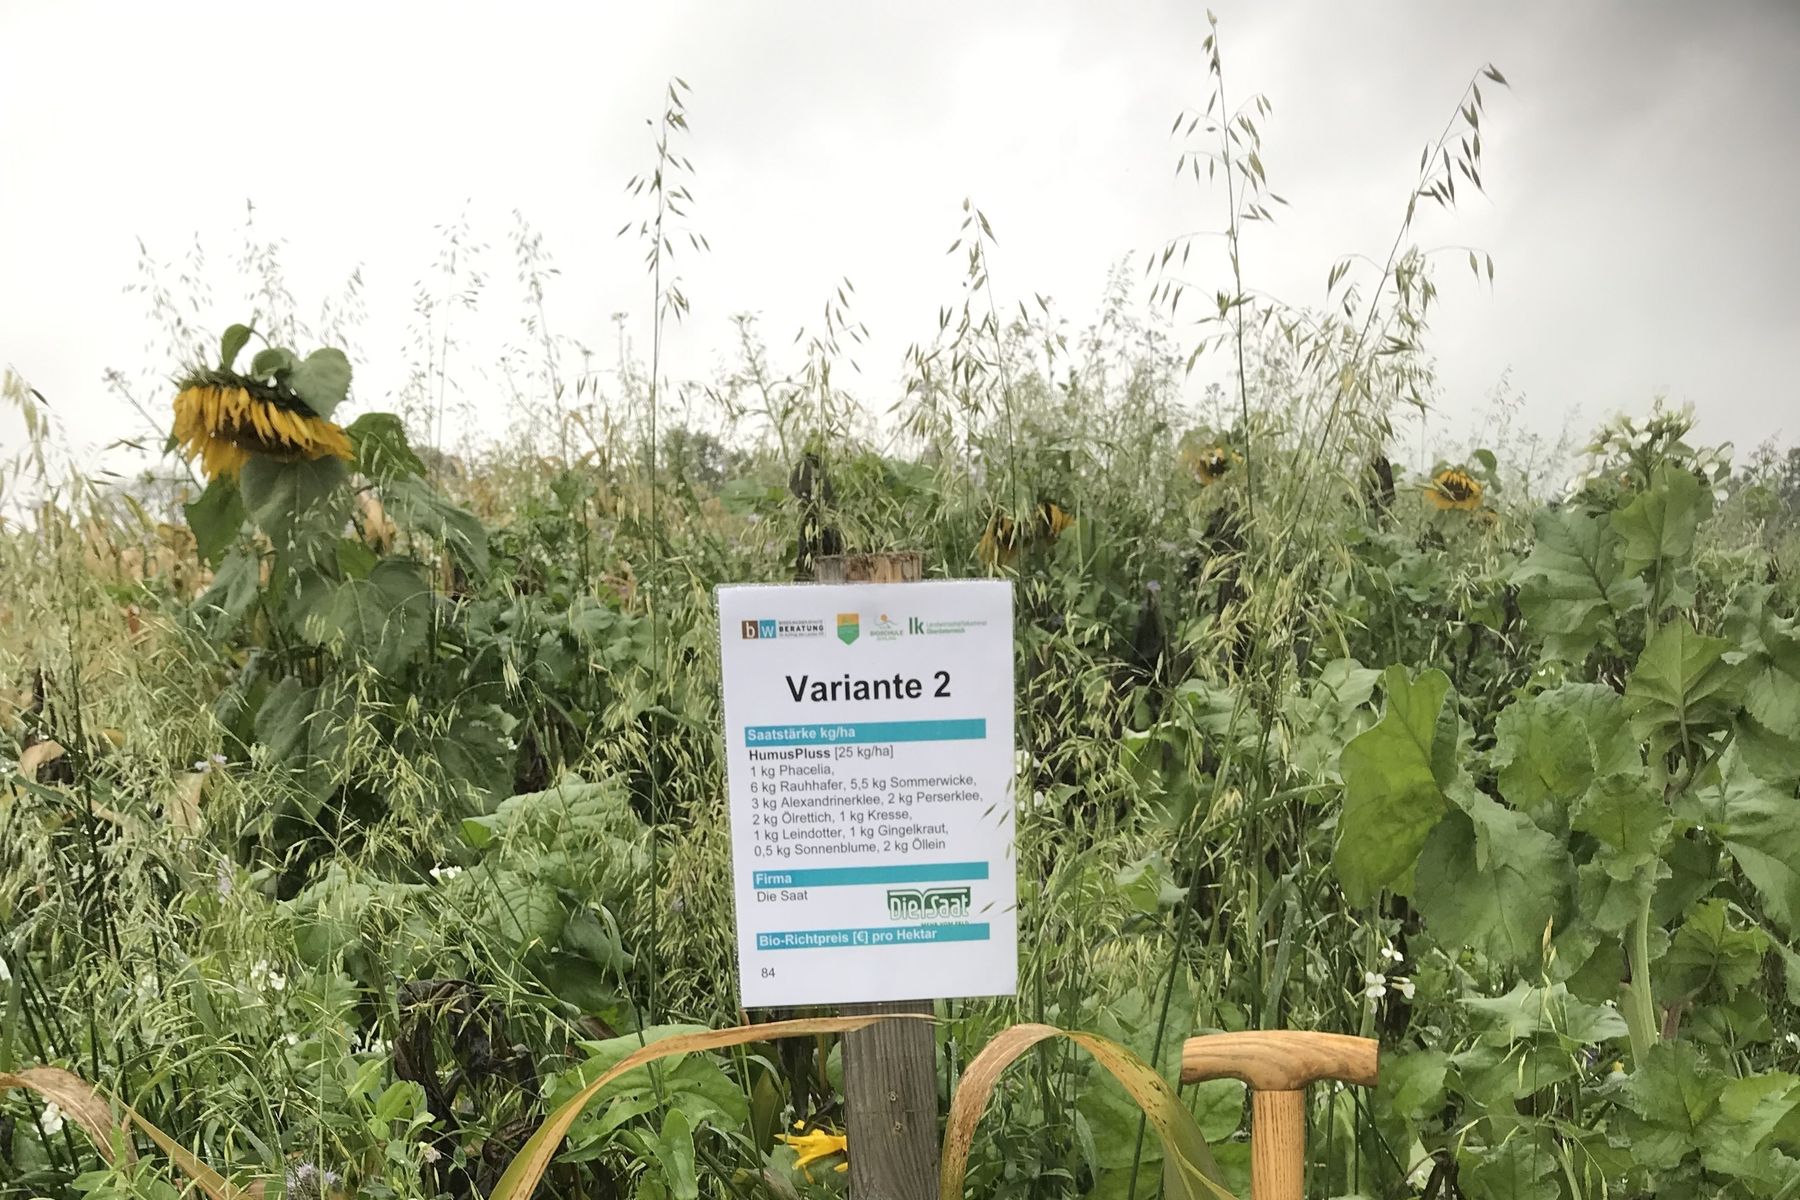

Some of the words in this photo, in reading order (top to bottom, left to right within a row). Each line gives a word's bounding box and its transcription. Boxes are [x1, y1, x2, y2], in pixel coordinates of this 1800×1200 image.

[779, 624, 824, 633] BERATUNG
[785, 673, 922, 702] Variante
[934, 670, 951, 698] 2
[747, 726, 816, 741] Saatstärke
[820, 726, 856, 740] kg/ha
[749, 748, 831, 761] HumusPluss
[834, 746, 854, 761] [25
[857, 744, 894, 760] kg/ha]
[750, 766, 756, 777] 1
[761, 765, 776, 779] kg
[780, 763, 835, 777] Phacelia,
[750, 782, 758, 793] 6
[762, 781, 776, 795] kg
[780, 779, 847, 793] Rauhhafer,
[850, 778, 869, 791] 5,5
[872, 777, 887, 791] kg
[890, 774, 977, 789] Sommerwicke,
[751, 798, 759, 809] 3
[763, 797, 777, 811] kg
[781, 794, 885, 810] Alexandrinerklee,
[888, 793, 895, 804] 2
[899, 792, 913, 806] kg
[916, 790, 984, 803] Perserklee,
[752, 813, 760, 825] 2
[764, 813, 778, 827] kg
[782, 811, 836, 824] Ölrettich,
[840, 810, 845, 822] 1
[850, 810, 864, 824] kg
[868, 809, 913, 822] Kresse,
[754, 830, 760, 841] 1
[764, 829, 779, 843] kg
[782, 827, 846, 840] Leindotter,
[850, 827, 856, 837] 1
[860, 826, 874, 839] kg
[878, 823, 949, 838] Gingelkraut,
[754, 845, 773, 858] 0,5
[777, 845, 791, 859] kg
[795, 841, 880, 856] Sonnenblume,
[883, 840, 891, 852] 2
[895, 840, 908, 854] kg
[912, 837, 946, 850] Öllein
[756, 873, 792, 885] Firma
[757, 890, 777, 903] Die
[781, 889, 808, 902] Saat
[890, 896, 920, 921] Die
[927, 893, 970, 918] Saat
[759, 932, 849, 947] Bio-Richtpreis
[853, 930, 868, 945] [€]
[872, 931, 893, 944] pro
[896, 929, 938, 941] Hektar
[761, 967, 775, 979] 84
